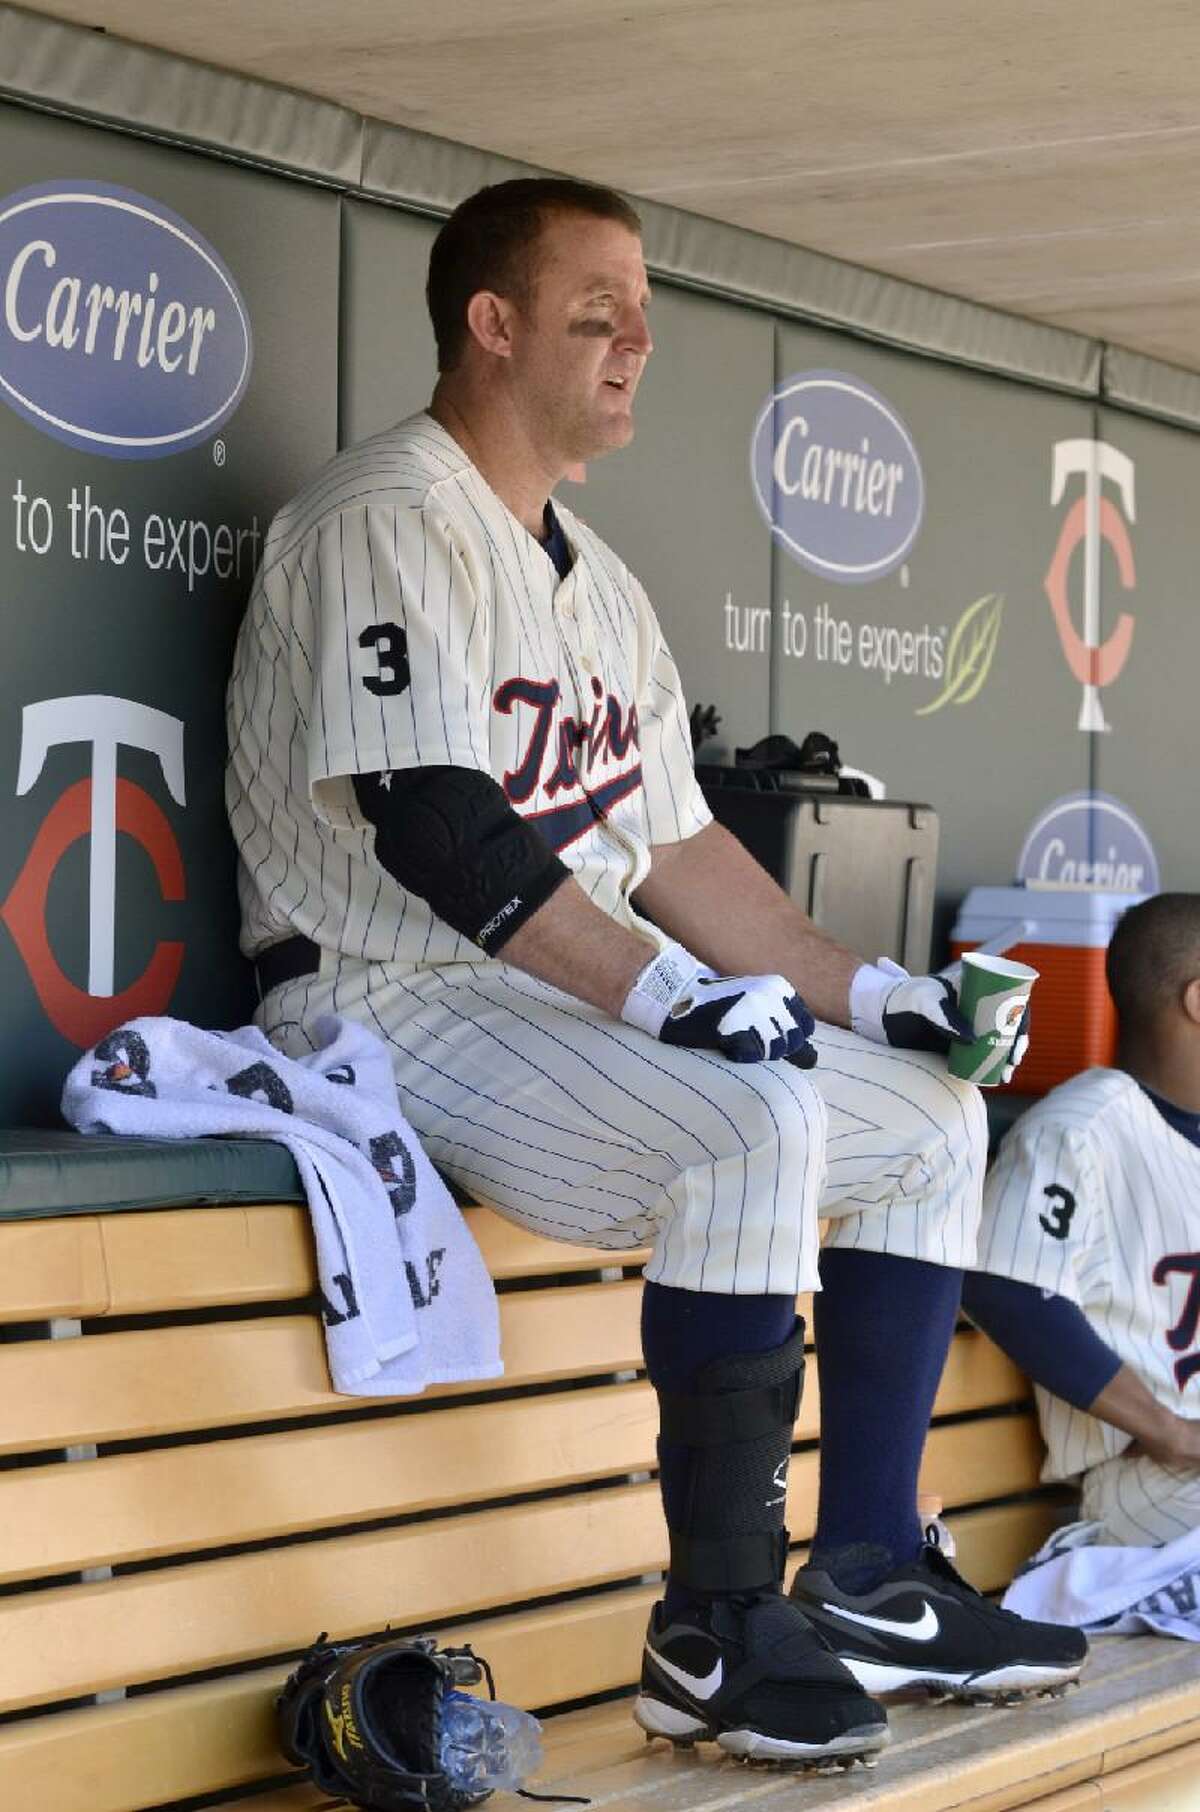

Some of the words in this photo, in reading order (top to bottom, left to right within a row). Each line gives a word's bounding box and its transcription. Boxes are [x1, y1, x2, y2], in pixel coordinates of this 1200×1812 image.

[5, 240, 215, 375] Carrier
[774, 415, 903, 517] Carrier
[13, 479, 53, 554] to
[67, 485, 130, 565] the
[359, 622, 411, 697] 3
[782, 600, 807, 658] to
[814, 603, 852, 665] the
[858, 624, 944, 685] experts
[1039, 1183, 1076, 1240] 3
